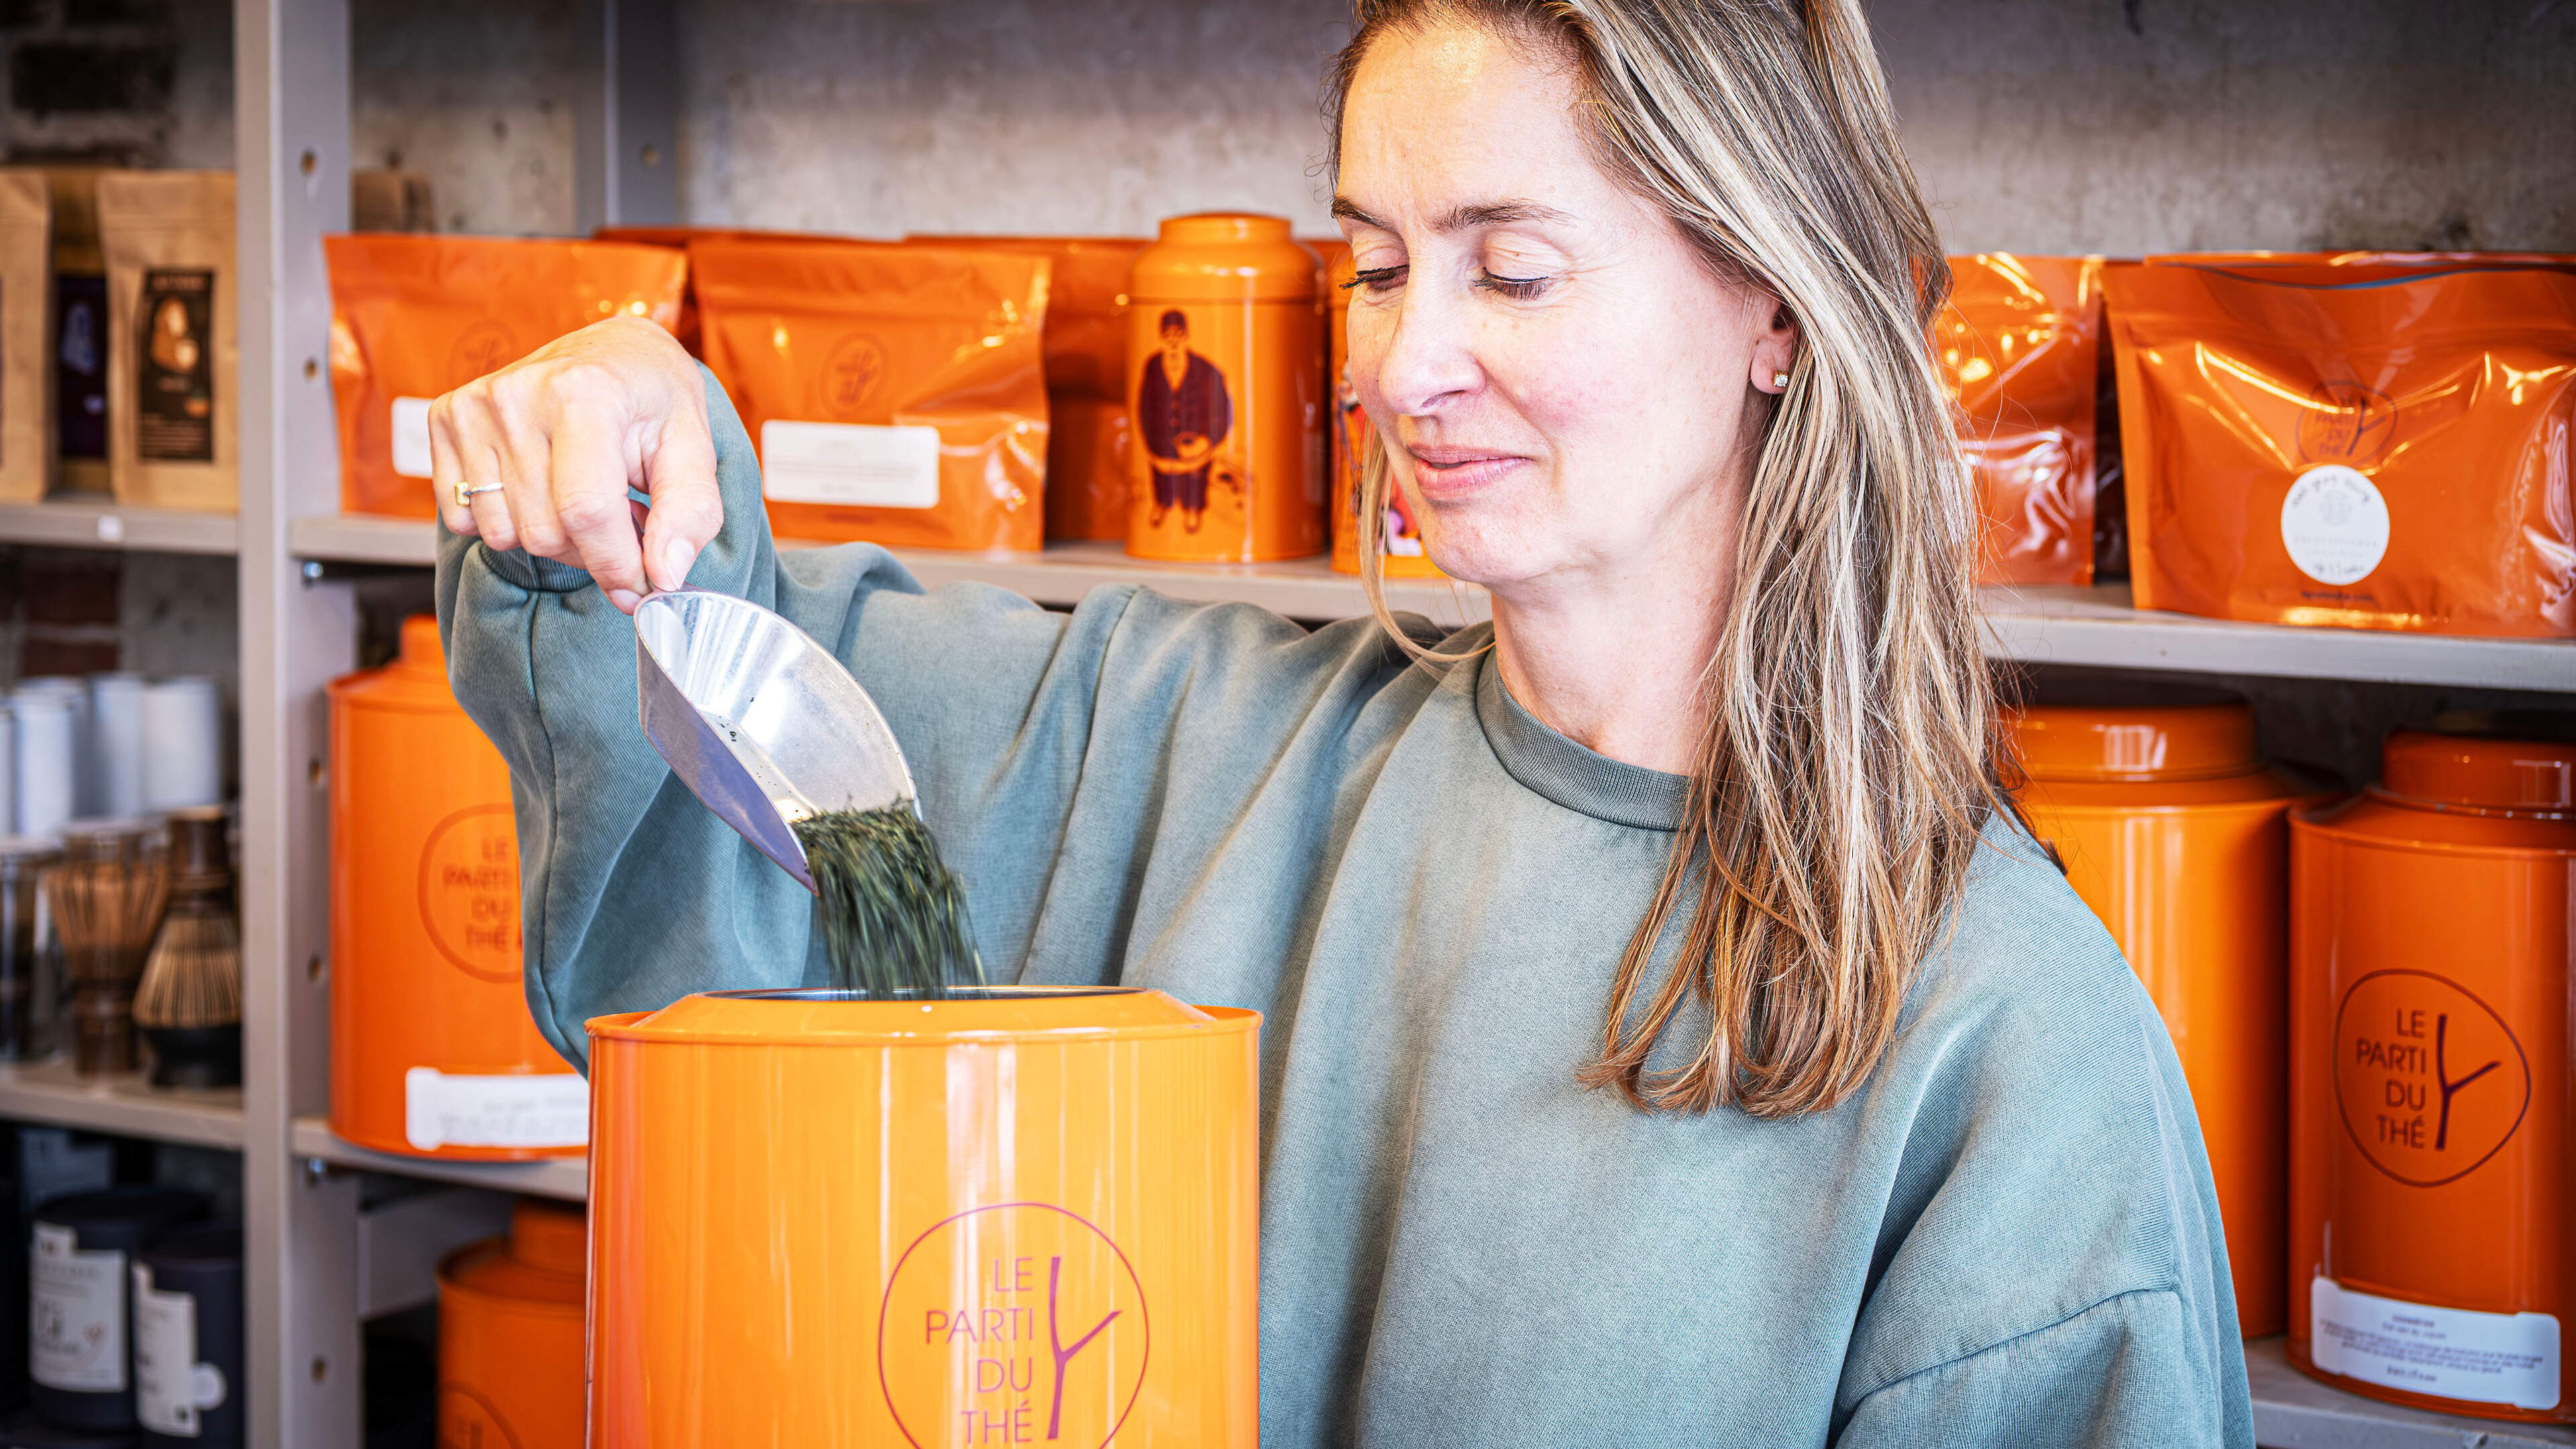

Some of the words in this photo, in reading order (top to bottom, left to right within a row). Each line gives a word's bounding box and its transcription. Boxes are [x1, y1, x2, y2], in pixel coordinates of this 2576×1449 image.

[471, 895, 513, 922] DU
[2397, 1008, 2425, 1038] LE
[2355, 1038, 2426, 1074] PARTI
[2385, 1079, 2425, 1111] DU
[2376, 1115, 2425, 1149] THÉ
[994, 1257, 1033, 1292] LE
[926, 1307, 1033, 1344] PARTI
[977, 1357, 1033, 1393] DU
[961, 1399, 1033, 1444] THÉ
